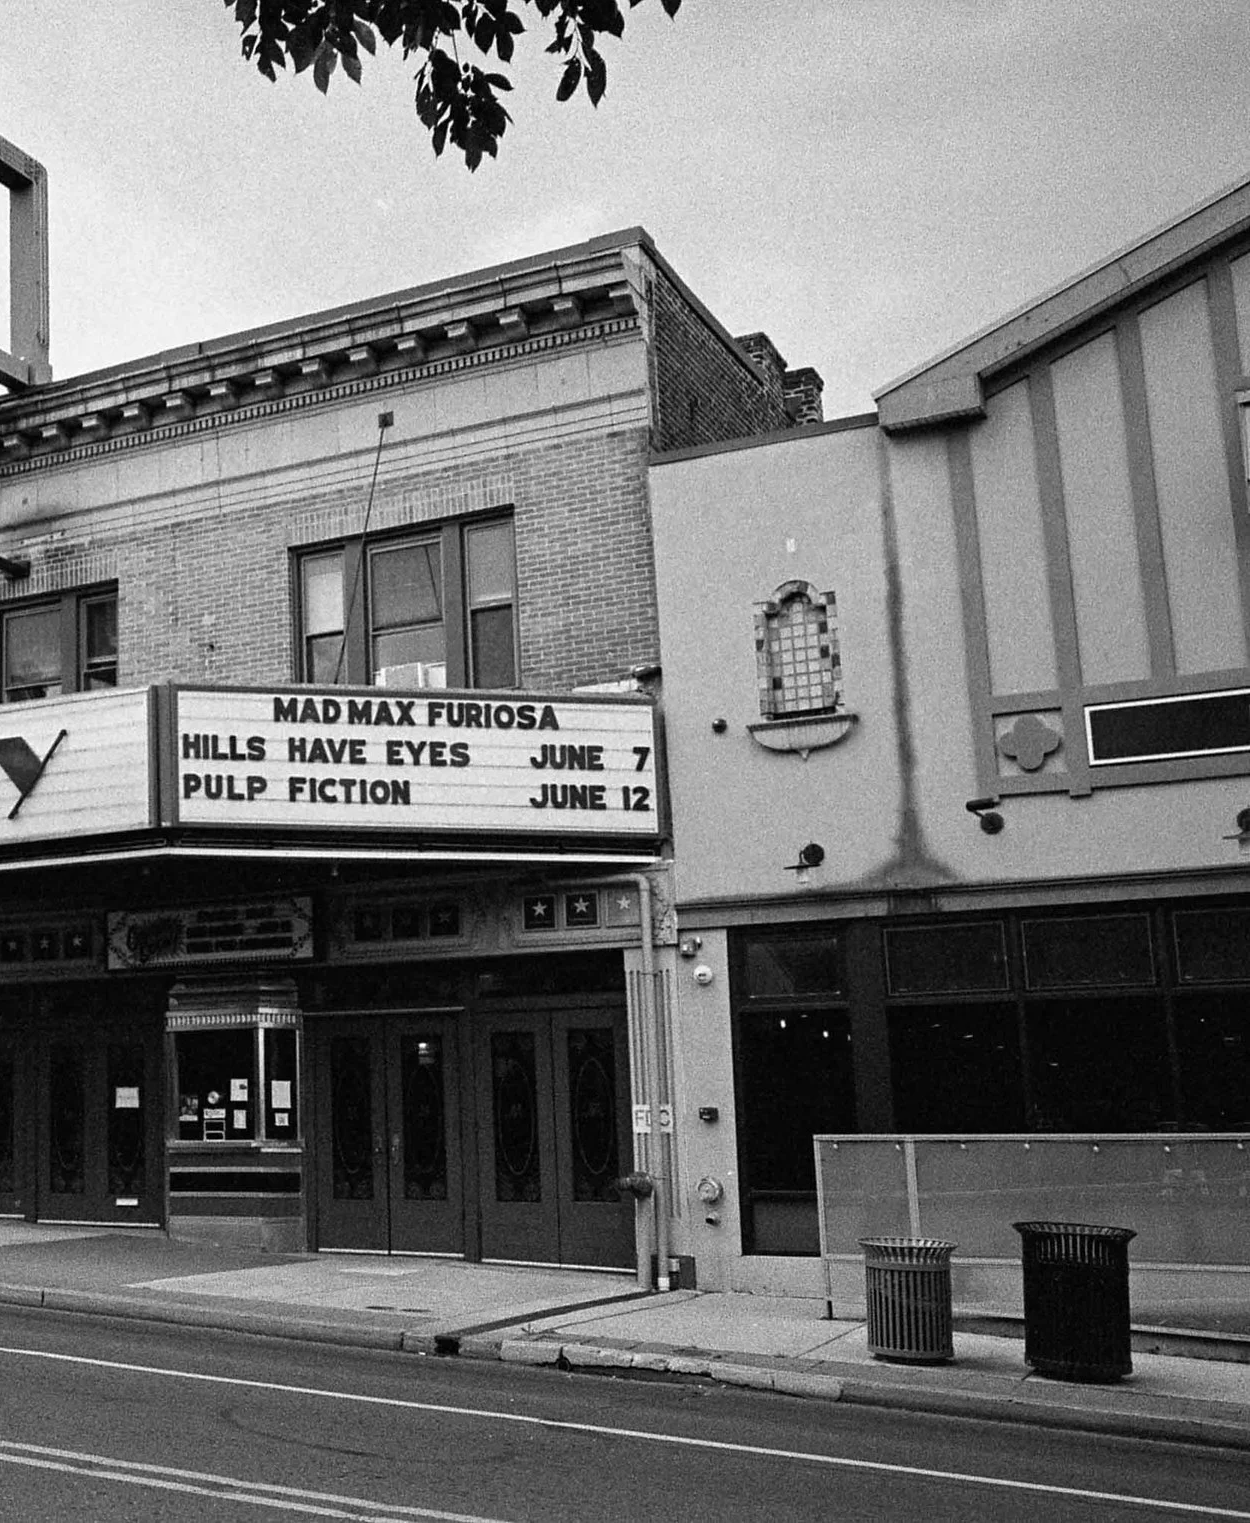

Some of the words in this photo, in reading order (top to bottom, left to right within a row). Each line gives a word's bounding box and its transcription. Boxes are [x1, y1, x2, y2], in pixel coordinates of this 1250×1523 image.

[273, 696, 342, 726] MAD
[348, 699, 417, 728] MAX
[427, 701, 560, 731] FURIOSA
[182, 733, 267, 761] HILLS
[287, 736, 367, 765] HAVE
[386, 740, 470, 768] EYES
[530, 744, 604, 771] JUNE
[632, 746, 650, 772] 7
[182, 773, 268, 802] PULP
[288, 777, 411, 805] FICTION
[530, 784, 607, 811] JUNE
[622, 785, 650, 812] 12
